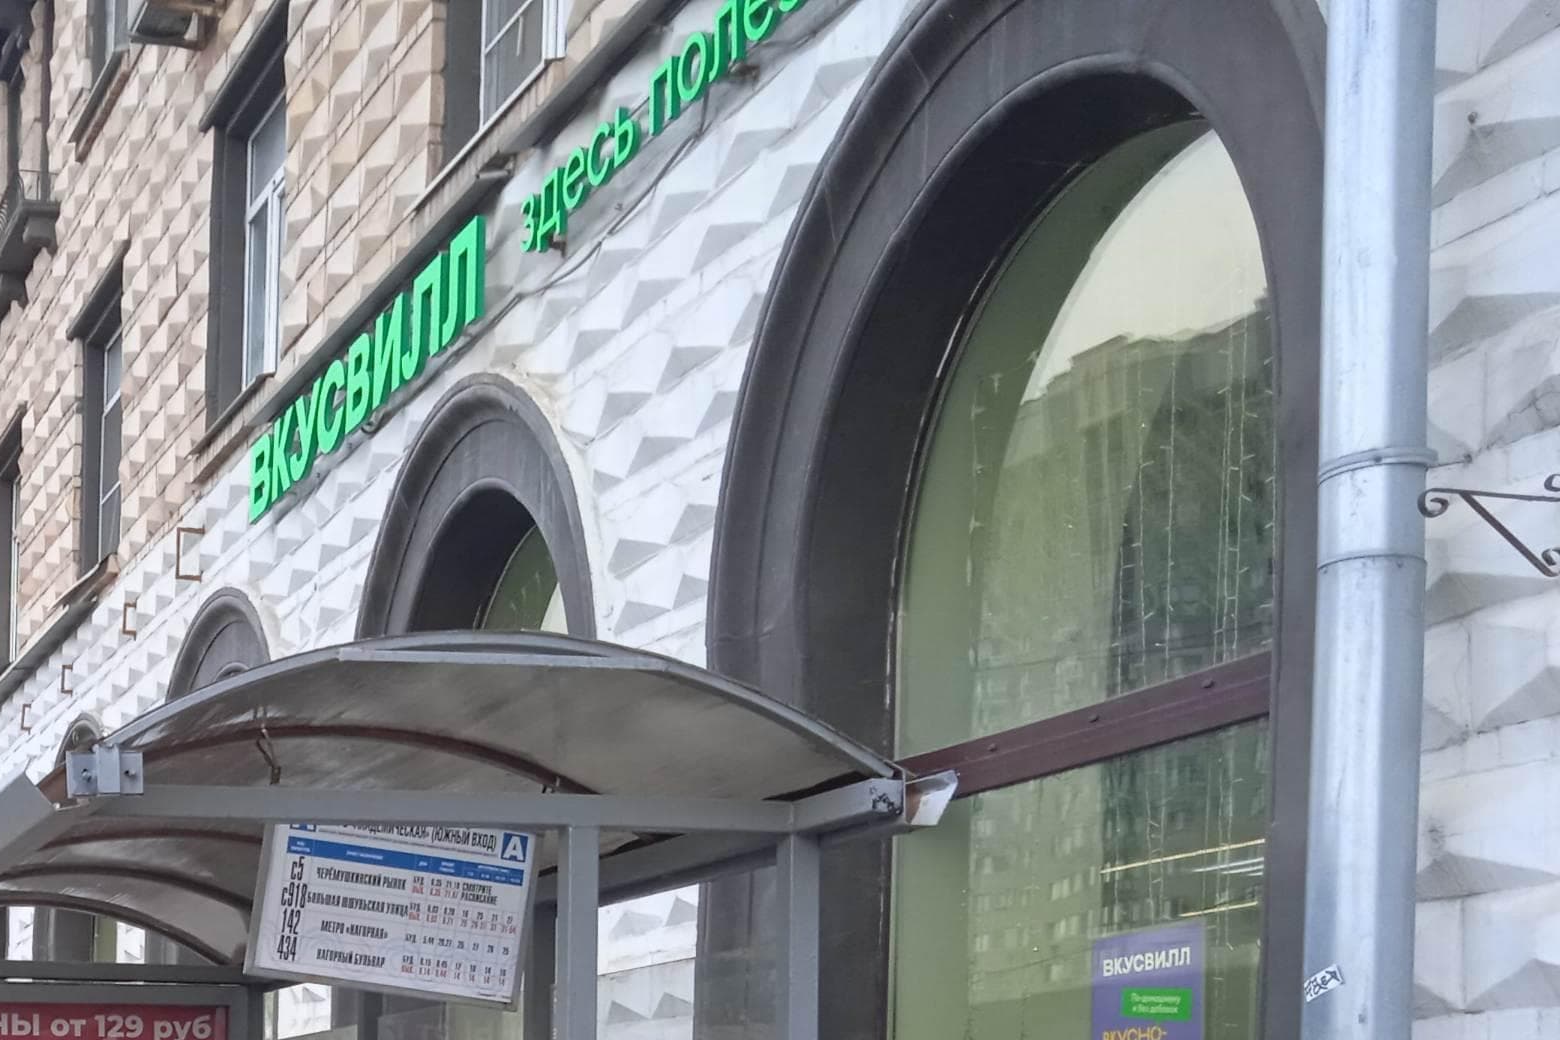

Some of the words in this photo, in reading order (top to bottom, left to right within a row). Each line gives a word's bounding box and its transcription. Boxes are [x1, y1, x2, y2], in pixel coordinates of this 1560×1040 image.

[249, 215, 486, 524] ВКУСВИЛЛ
[648, 0, 803, 136] поле
[471, 832, 497, 852] ВХОД)
[281, 908, 301, 935] 142
[320, 920, 345, 934] МЕТРО
[277, 935, 297, 961] 434
[1102, 947, 1191, 977] ВКУСВИЛЛ
[50, 1016, 87, 1037] от
[94, 1014, 145, 1038] 129
